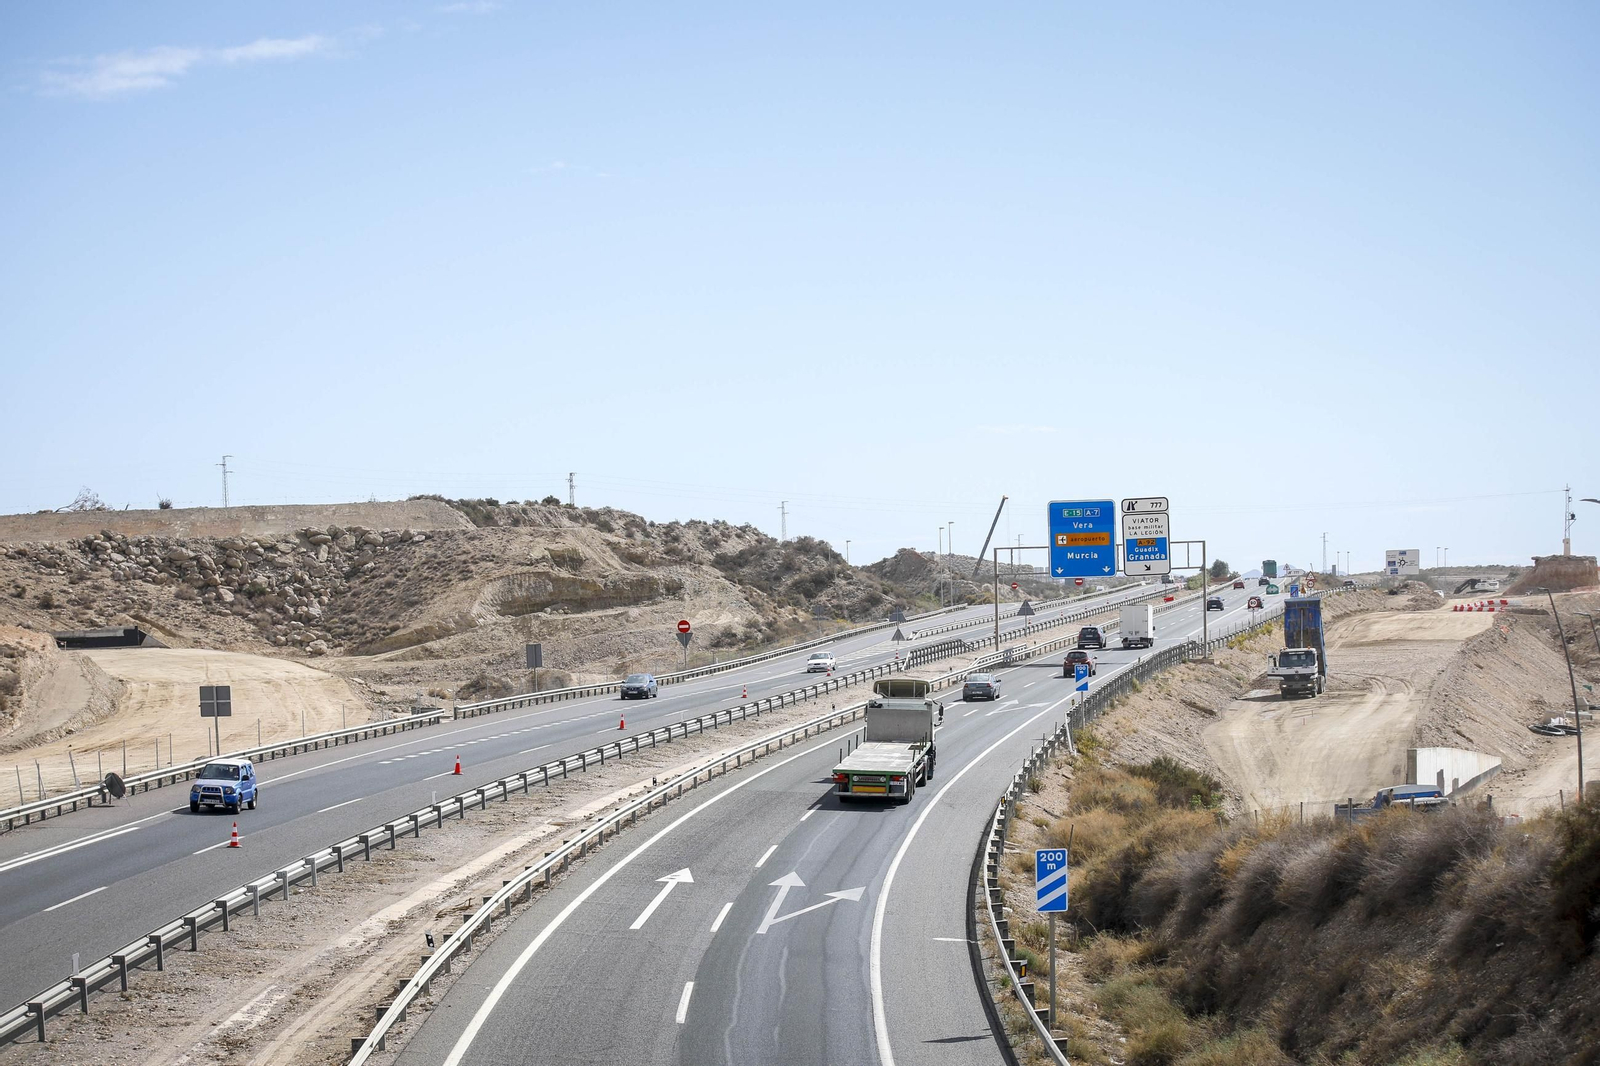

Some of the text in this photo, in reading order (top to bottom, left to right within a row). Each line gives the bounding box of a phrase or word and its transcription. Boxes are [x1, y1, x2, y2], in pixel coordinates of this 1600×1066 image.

[1067, 552, 1098, 560] Murcia
[1128, 553, 1166, 561] Granada
[1040, 852, 1062, 862] 200
